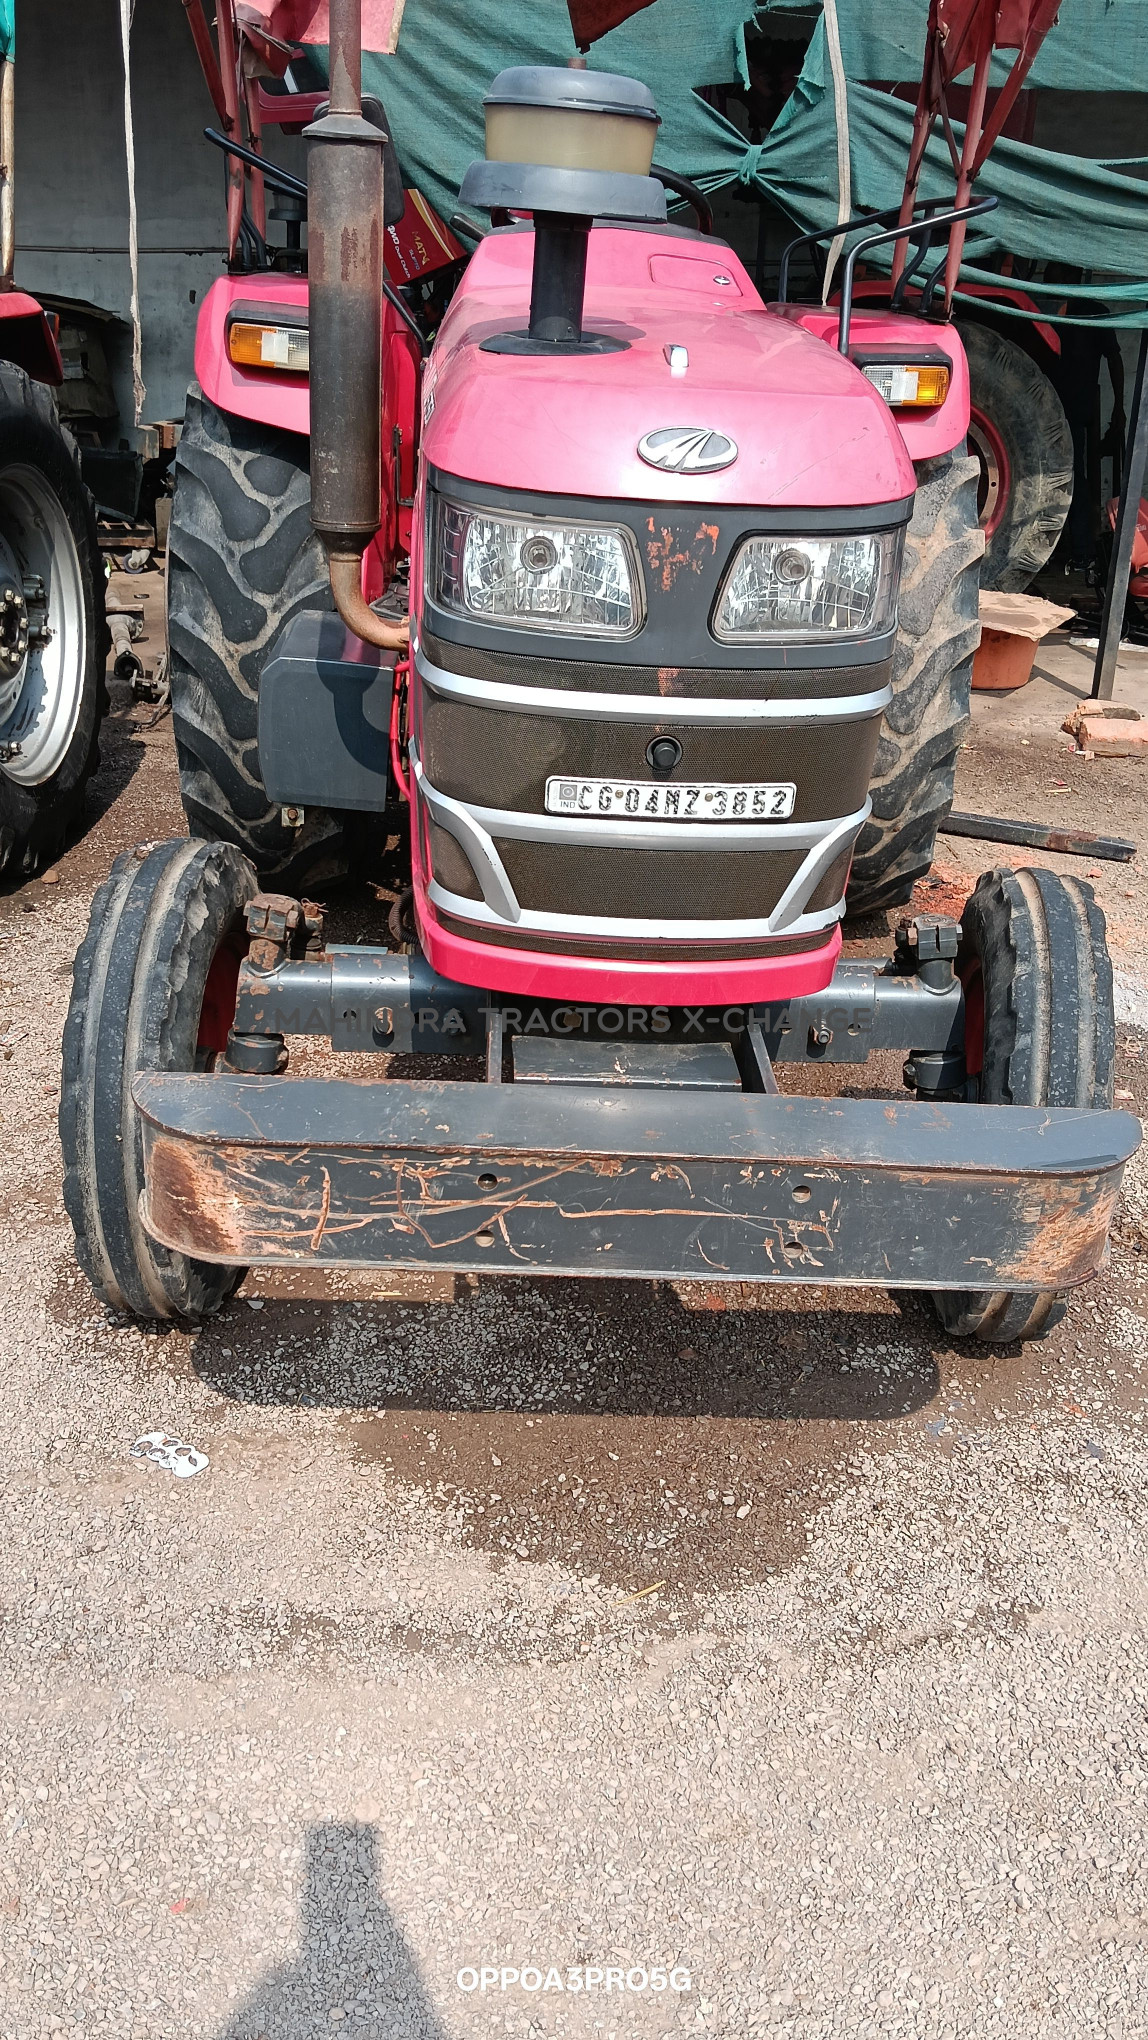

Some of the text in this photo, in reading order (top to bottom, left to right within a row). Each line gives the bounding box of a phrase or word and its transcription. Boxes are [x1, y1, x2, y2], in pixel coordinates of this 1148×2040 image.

[559, 801, 576, 809] IND
[578, 785, 613, 812] CG
[711, 790, 787, 816] 3852
